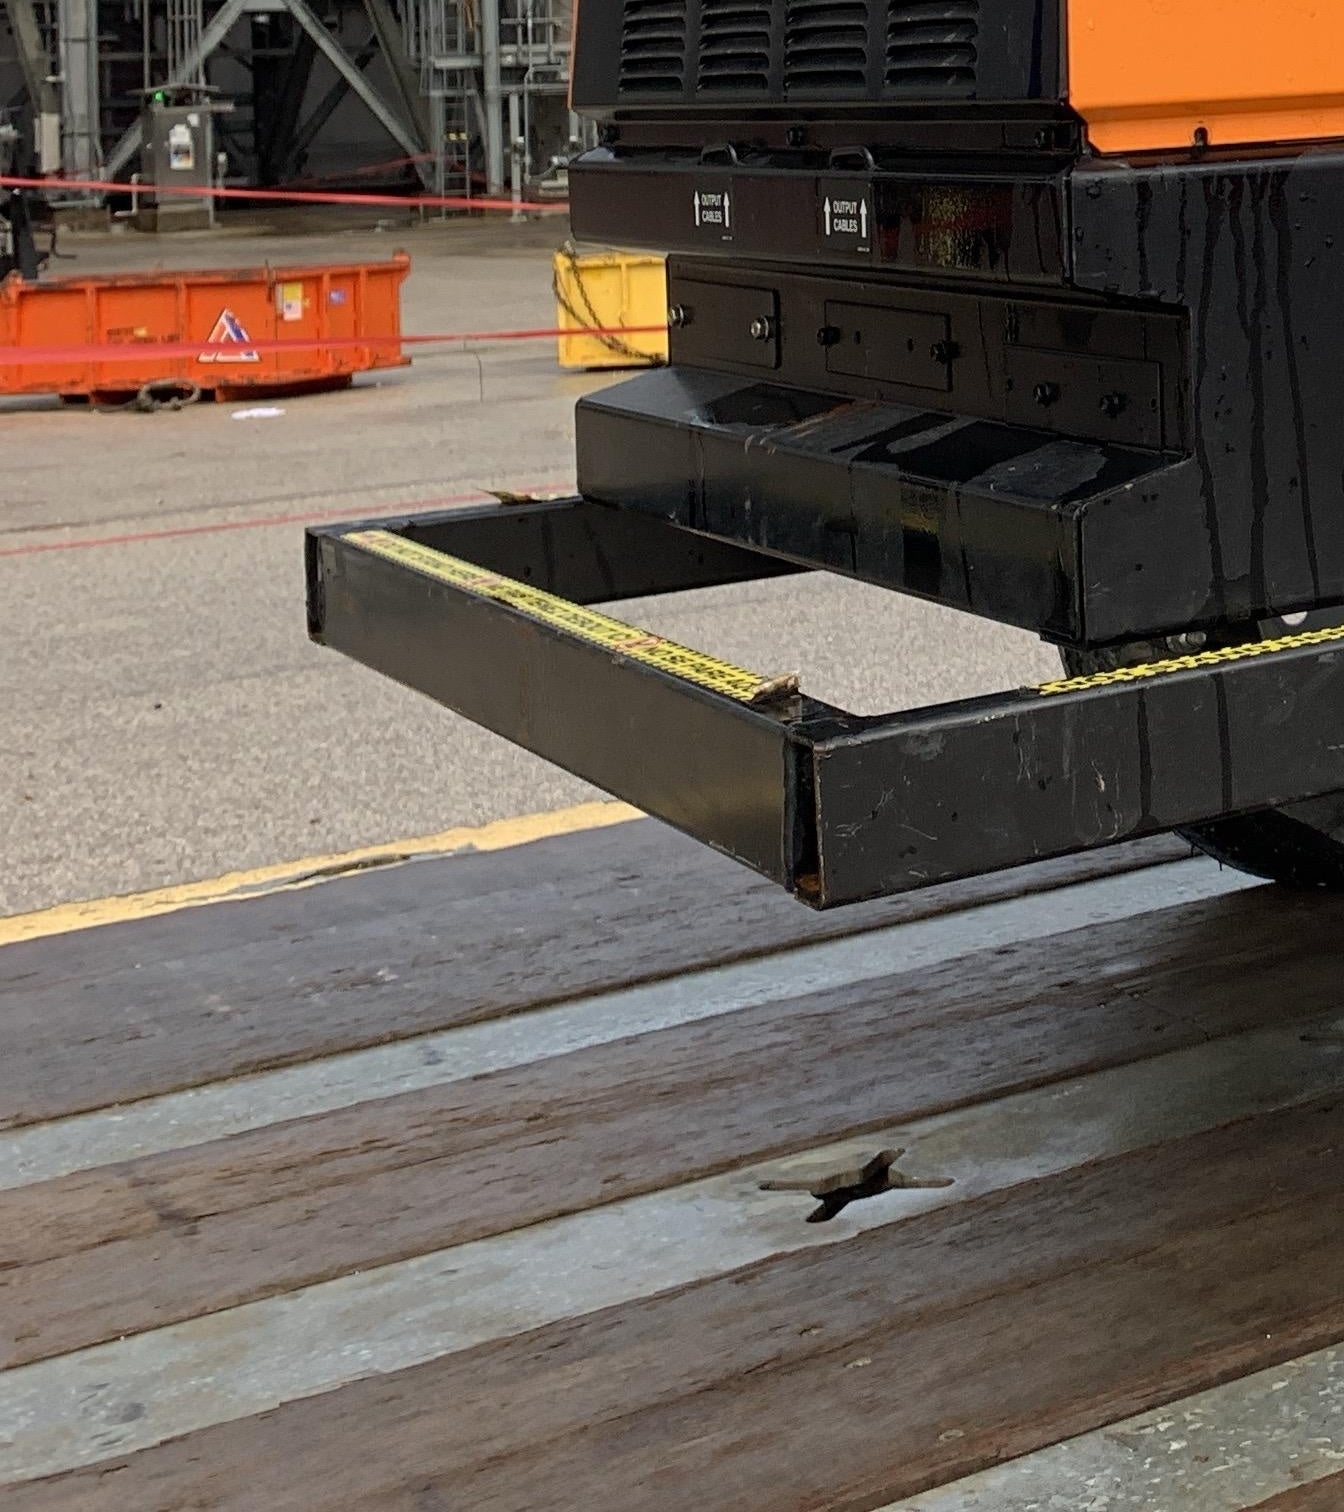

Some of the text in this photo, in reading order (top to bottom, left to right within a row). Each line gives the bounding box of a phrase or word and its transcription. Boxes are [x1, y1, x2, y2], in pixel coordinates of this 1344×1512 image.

[701, 194, 721, 206] OUTPUT
[832, 200, 858, 215] OUTPUT
[702, 210, 723, 224] CABLES
[833, 218, 858, 233] CABLES
